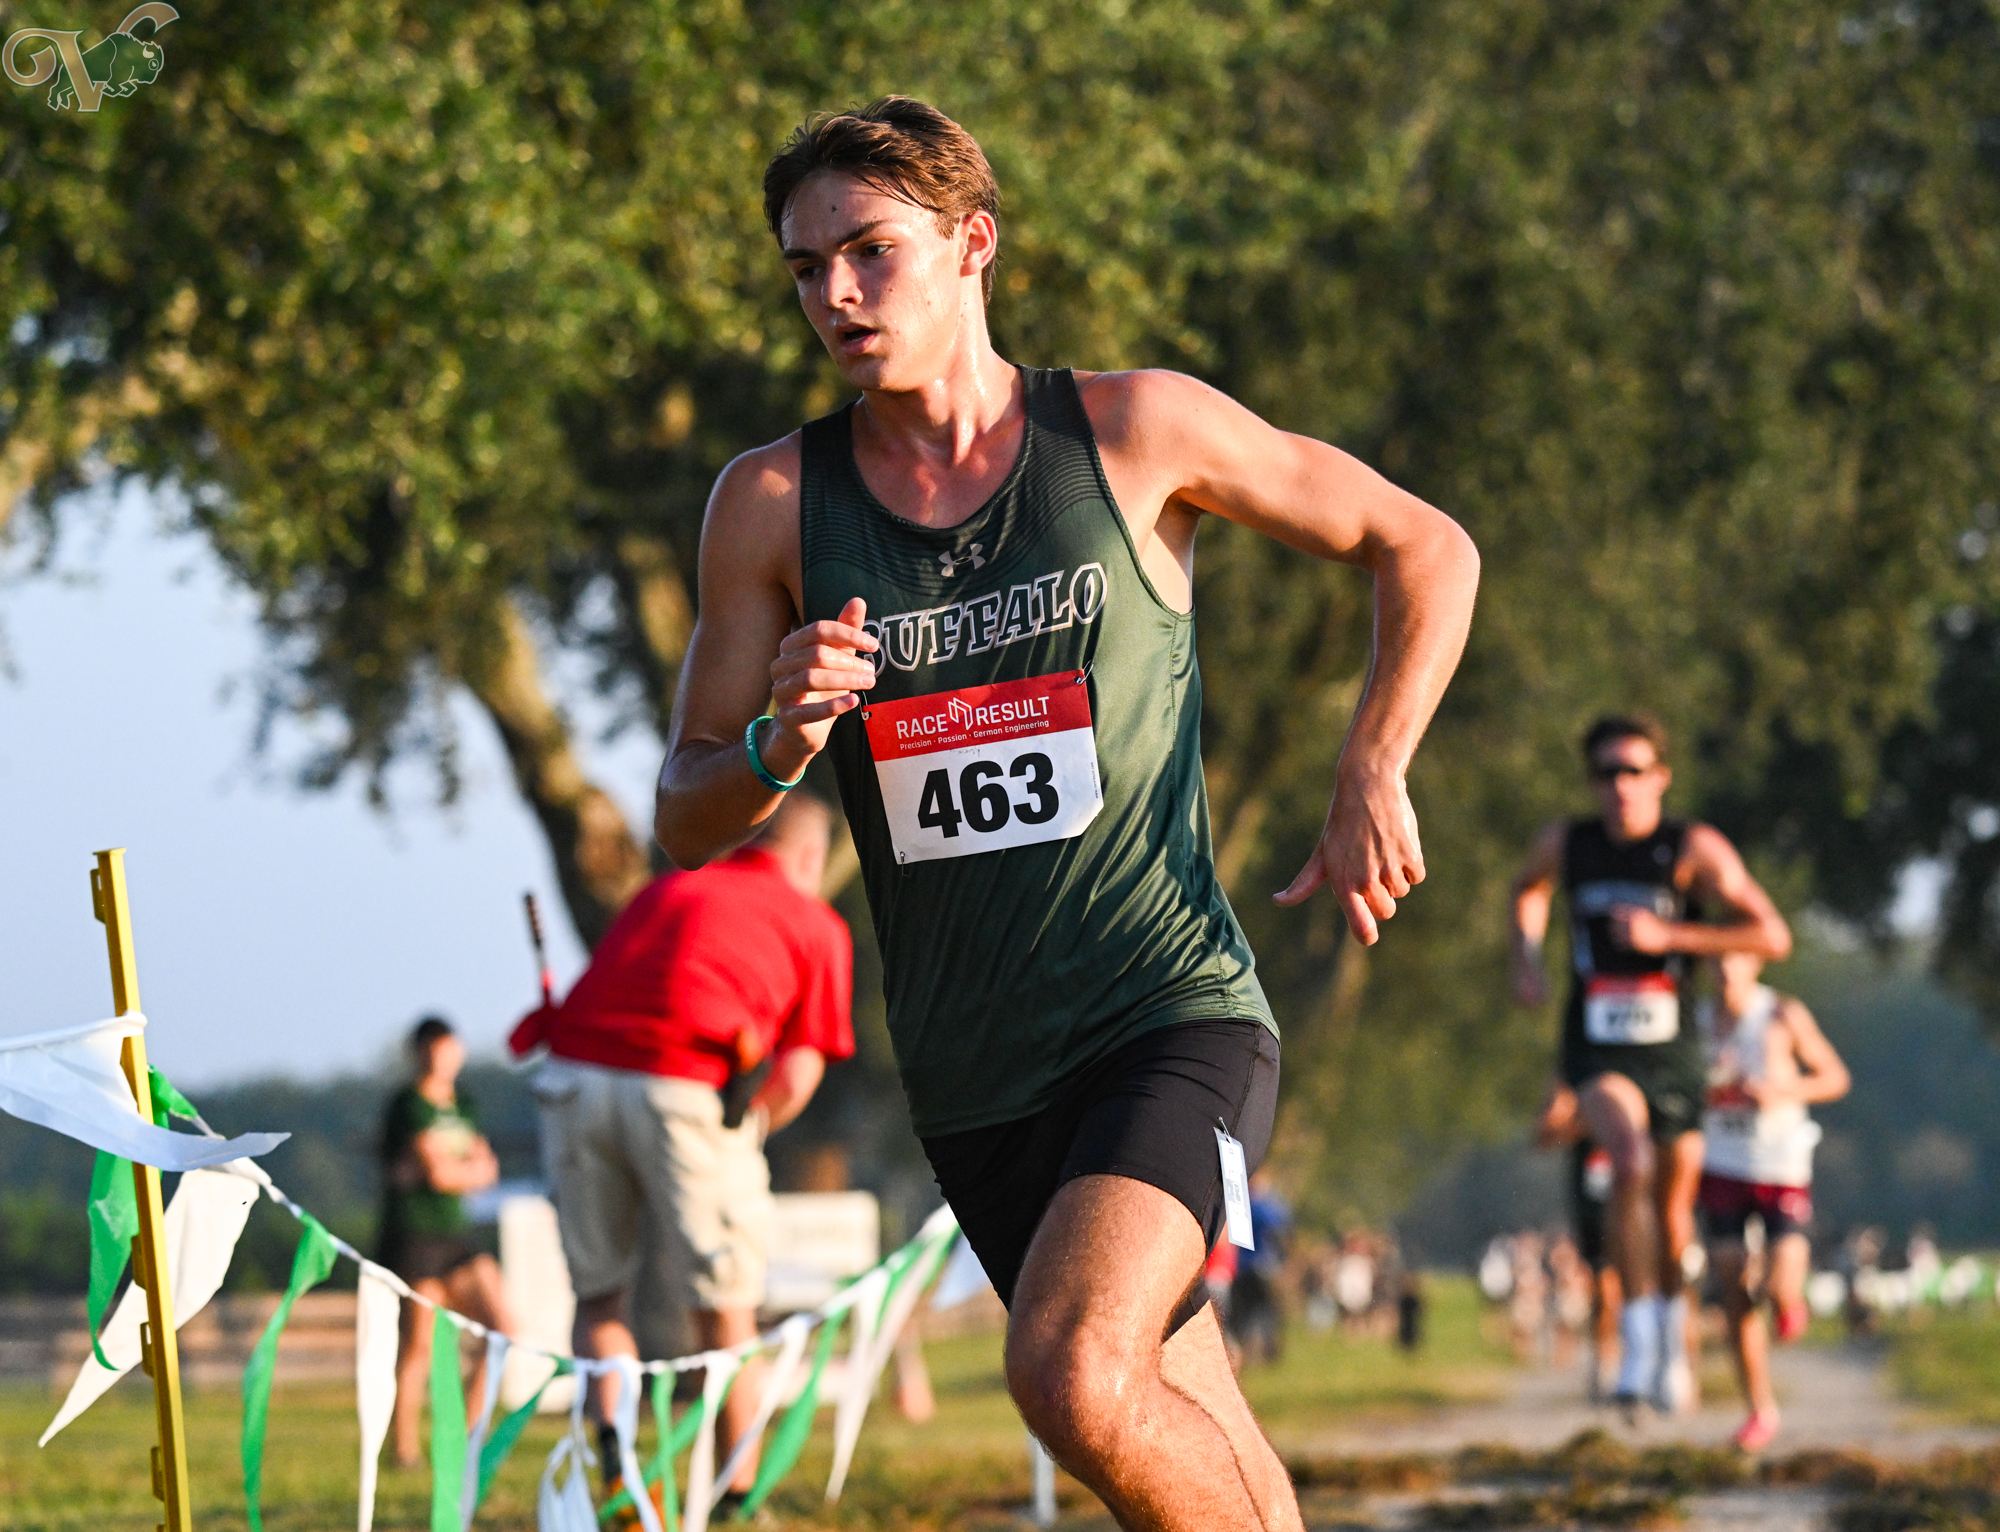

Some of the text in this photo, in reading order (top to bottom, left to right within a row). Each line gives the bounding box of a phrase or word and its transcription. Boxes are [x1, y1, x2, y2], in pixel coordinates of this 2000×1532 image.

[896, 696, 1050, 740] RACE RESULT
[900, 720, 1050, 750] Precision Passion German Engineering
[917, 752, 1060, 839] 463
